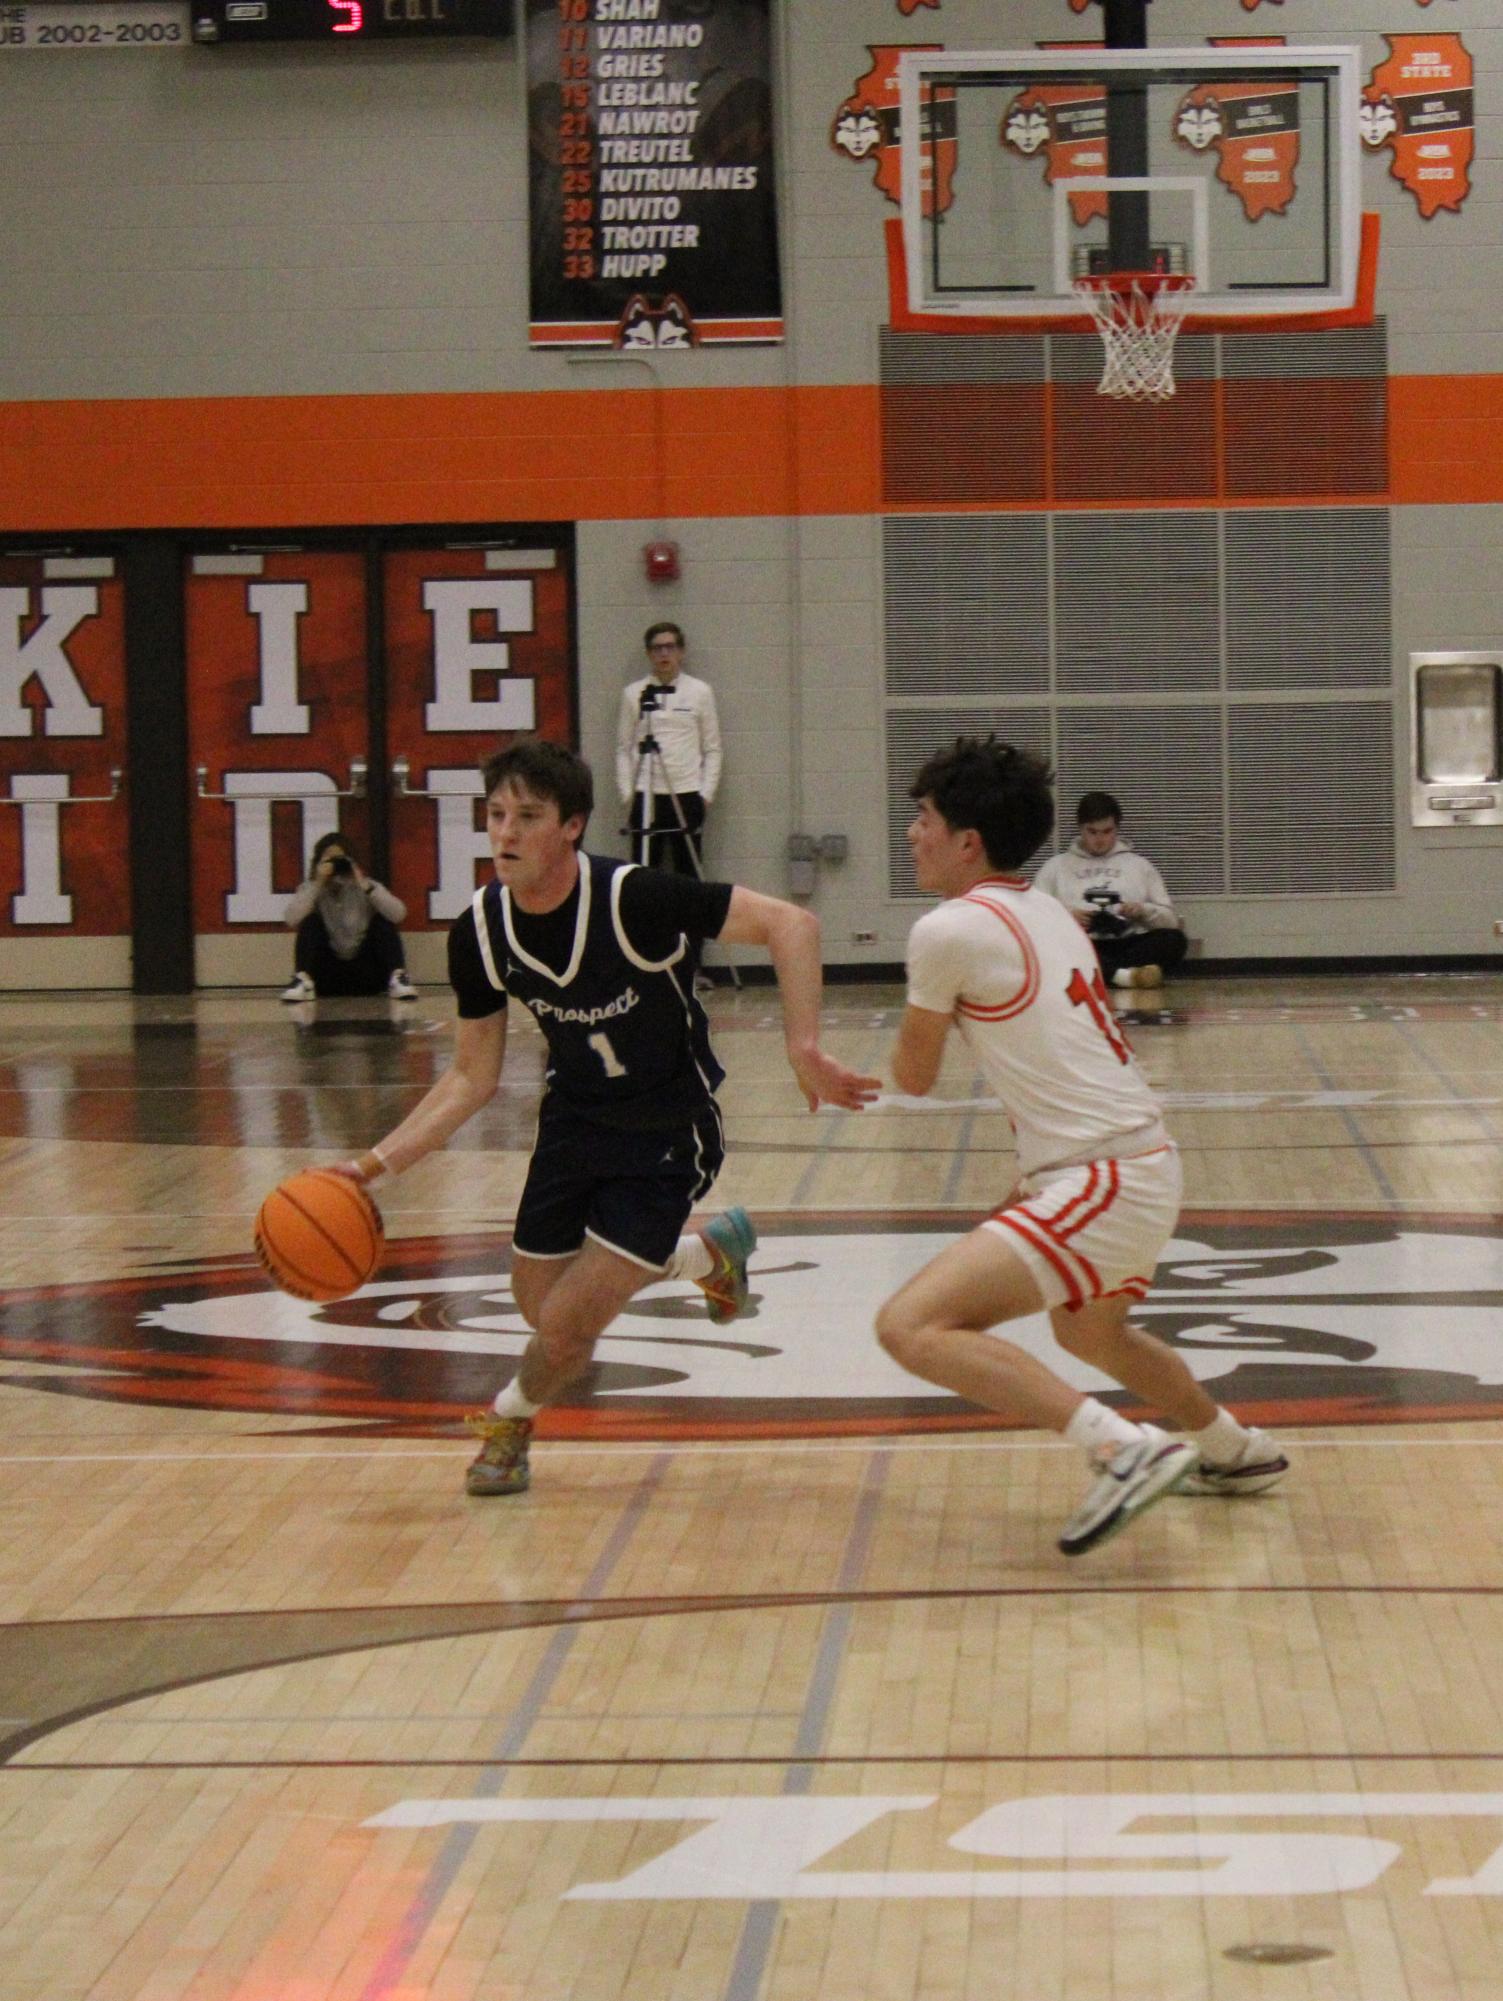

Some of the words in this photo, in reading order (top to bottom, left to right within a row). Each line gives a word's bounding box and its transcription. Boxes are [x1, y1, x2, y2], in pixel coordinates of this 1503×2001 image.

[595, 0, 660, 20] SHAH
[38, 23, 181, 43] 2002-2003
[560, 26, 588, 51] 11
[597, 24, 703, 48] VARIANO
[561, 54, 590, 79] 12
[598, 54, 664, 77] GRIES
[1401, 65, 1452, 78] STATE
[562, 84, 590, 108] 15
[599, 82, 700, 106] LEBLANC
[560, 113, 590, 137] 21
[599, 110, 700, 134] NAWROT
[561, 141, 592, 164] 22
[600, 139, 694, 163] TREUTEL
[561, 170, 592, 193] 25
[600, 166, 758, 192] KUTRUMANES
[562, 198, 592, 221] 30
[601, 197, 681, 221] DIVITO
[563, 227, 593, 250] 32
[602, 225, 700, 249] TROTTER
[563, 256, 594, 279] 33
[602, 254, 667, 278] HUPP
[527, 985, 640, 1026] Prospect
[588, 1032, 627, 1077] 1
